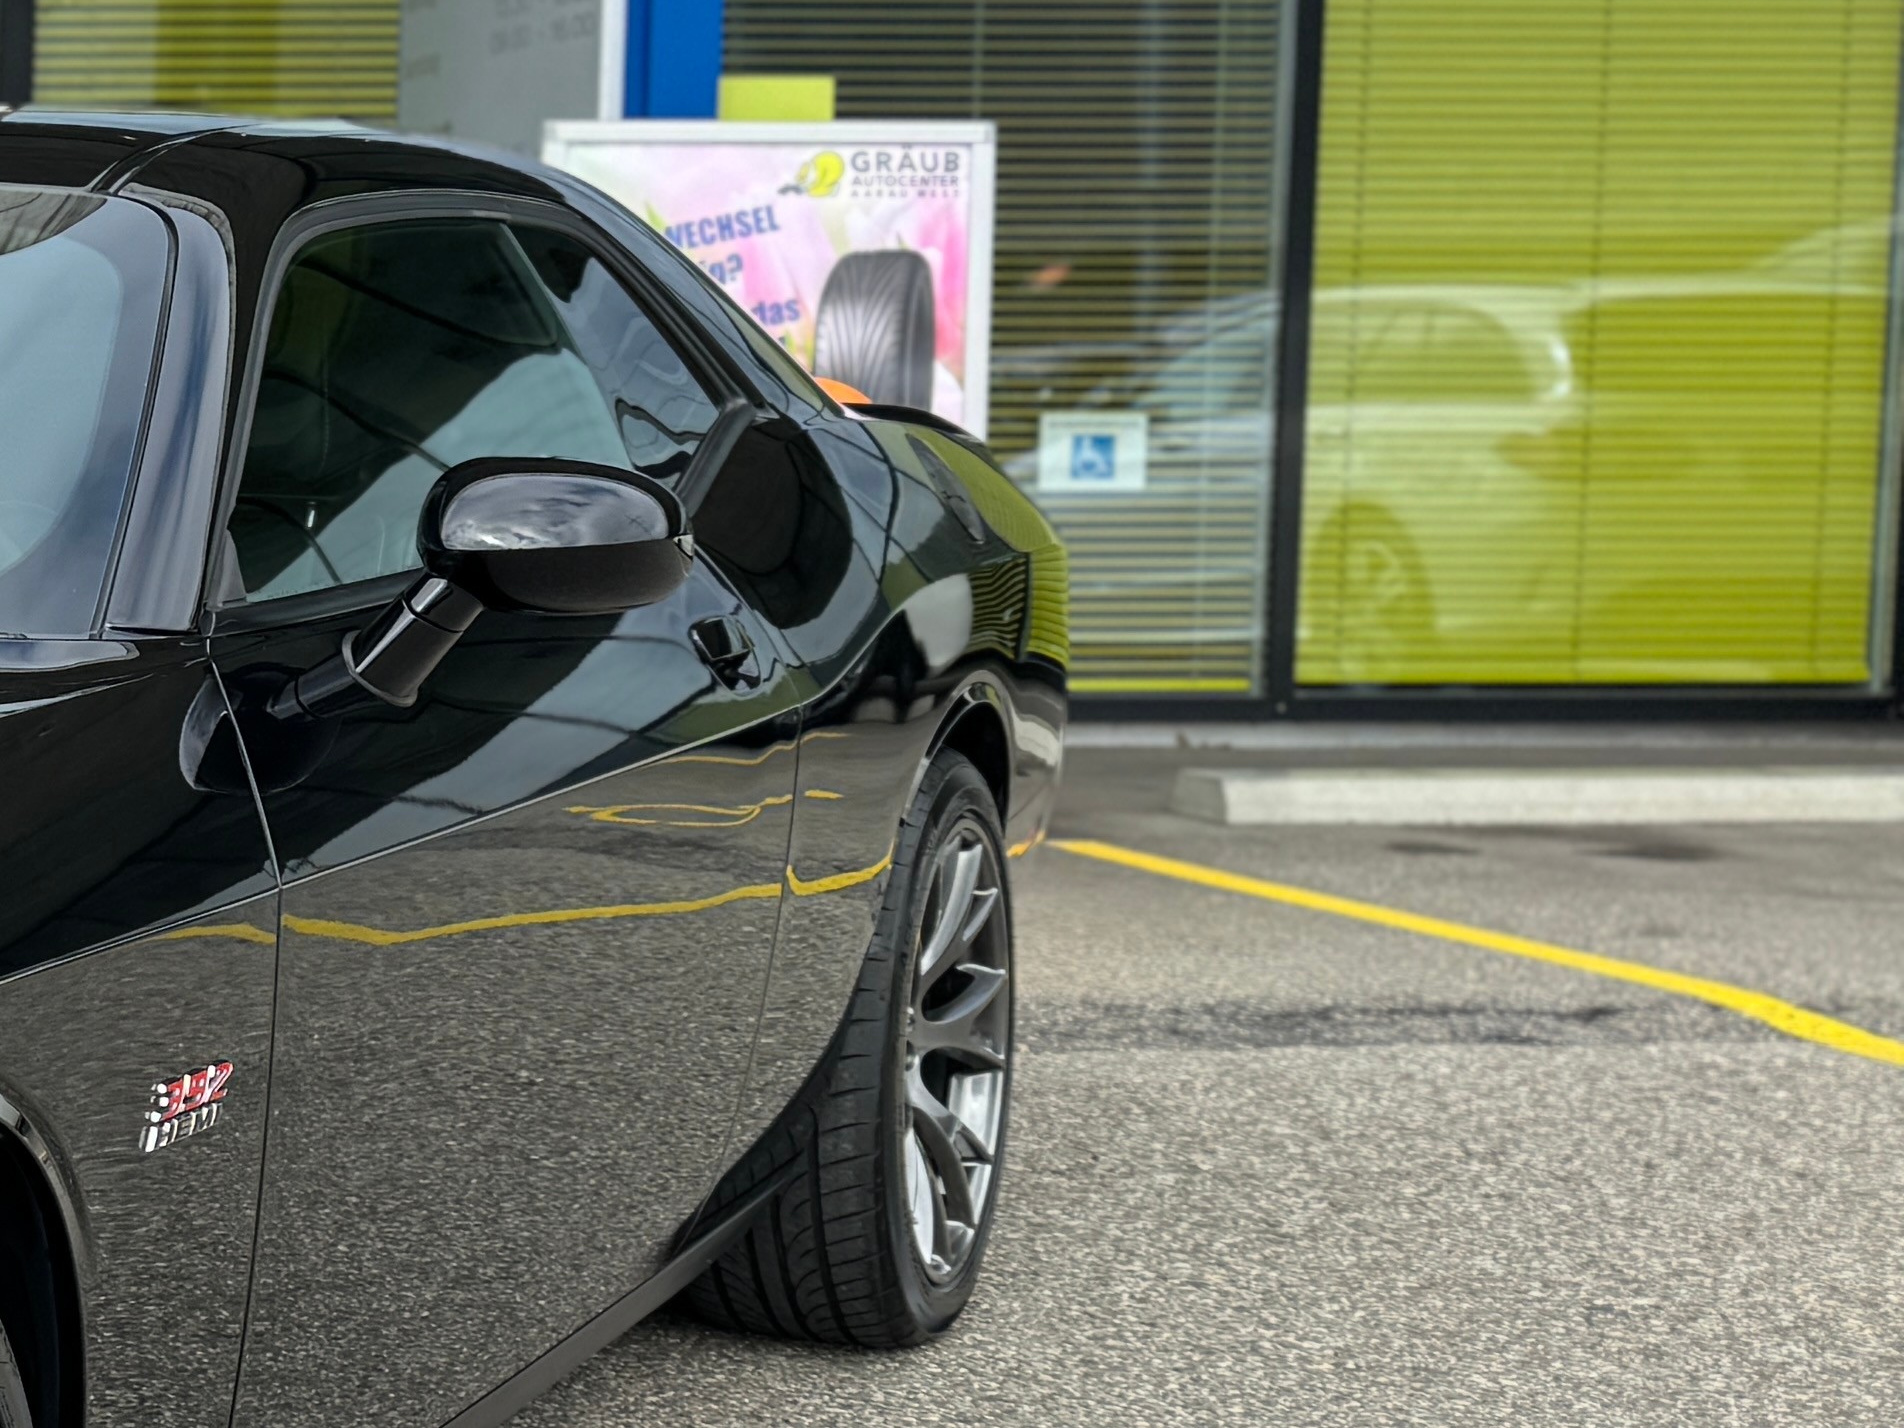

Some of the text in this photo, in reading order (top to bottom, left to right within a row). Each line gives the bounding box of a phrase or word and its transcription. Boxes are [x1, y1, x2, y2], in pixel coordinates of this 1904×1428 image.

[851, 146, 960, 173] GRÄUB
[852, 175, 959, 187] AUTOCENTER
[851, 189, 908, 198] AARAU
